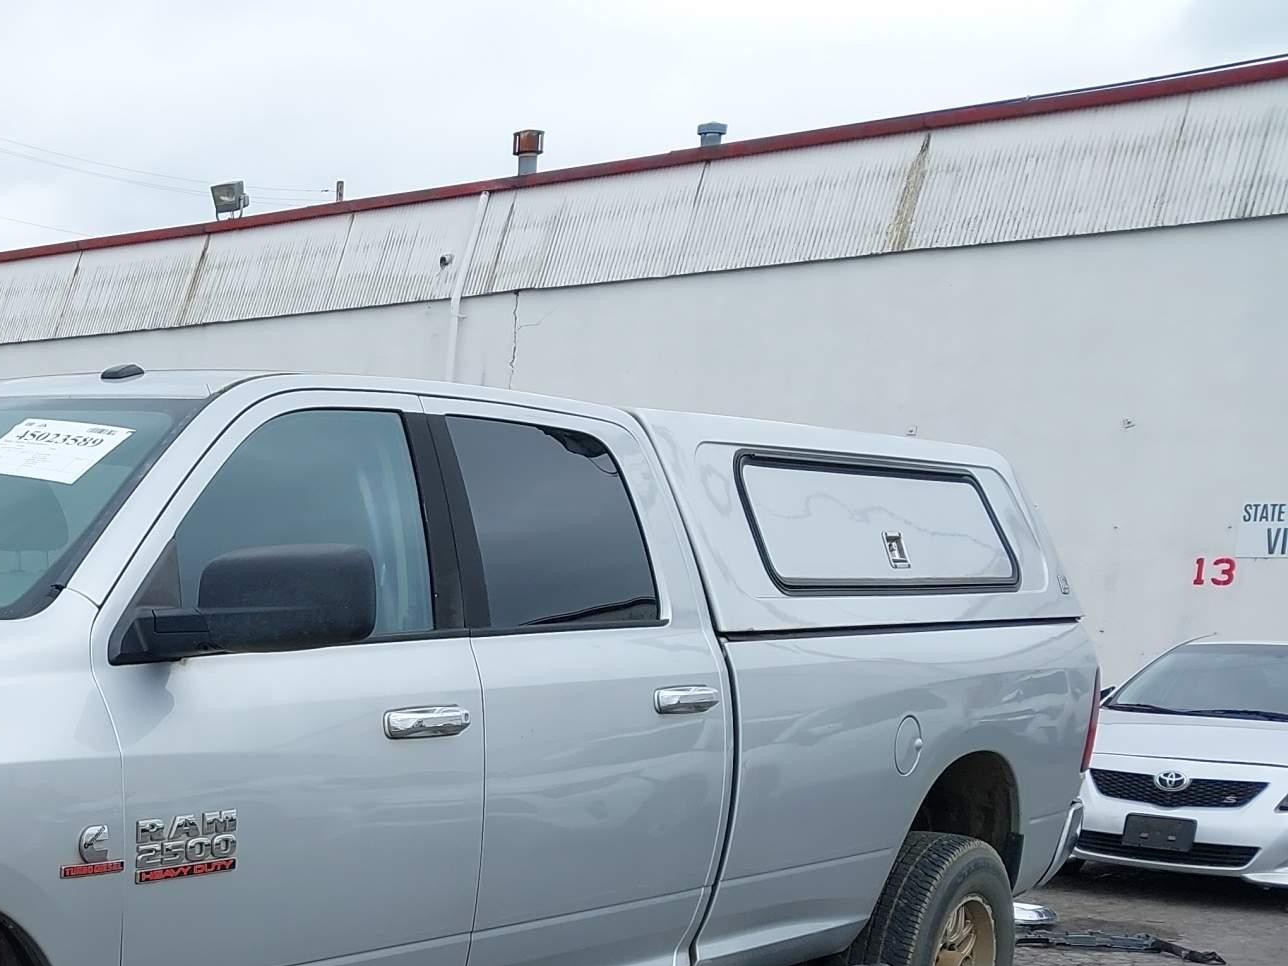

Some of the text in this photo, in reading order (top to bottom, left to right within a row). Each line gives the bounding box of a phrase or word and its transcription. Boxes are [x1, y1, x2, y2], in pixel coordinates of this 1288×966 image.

[16, 429, 104, 448] 45023589
[1243, 503, 1287, 522] STATE
[1193, 557, 1236, 587] 13
[136, 808, 237, 842] RAM
[136, 833, 237, 868] 2500
[142, 860, 234, 881] HEAVY DUTY
